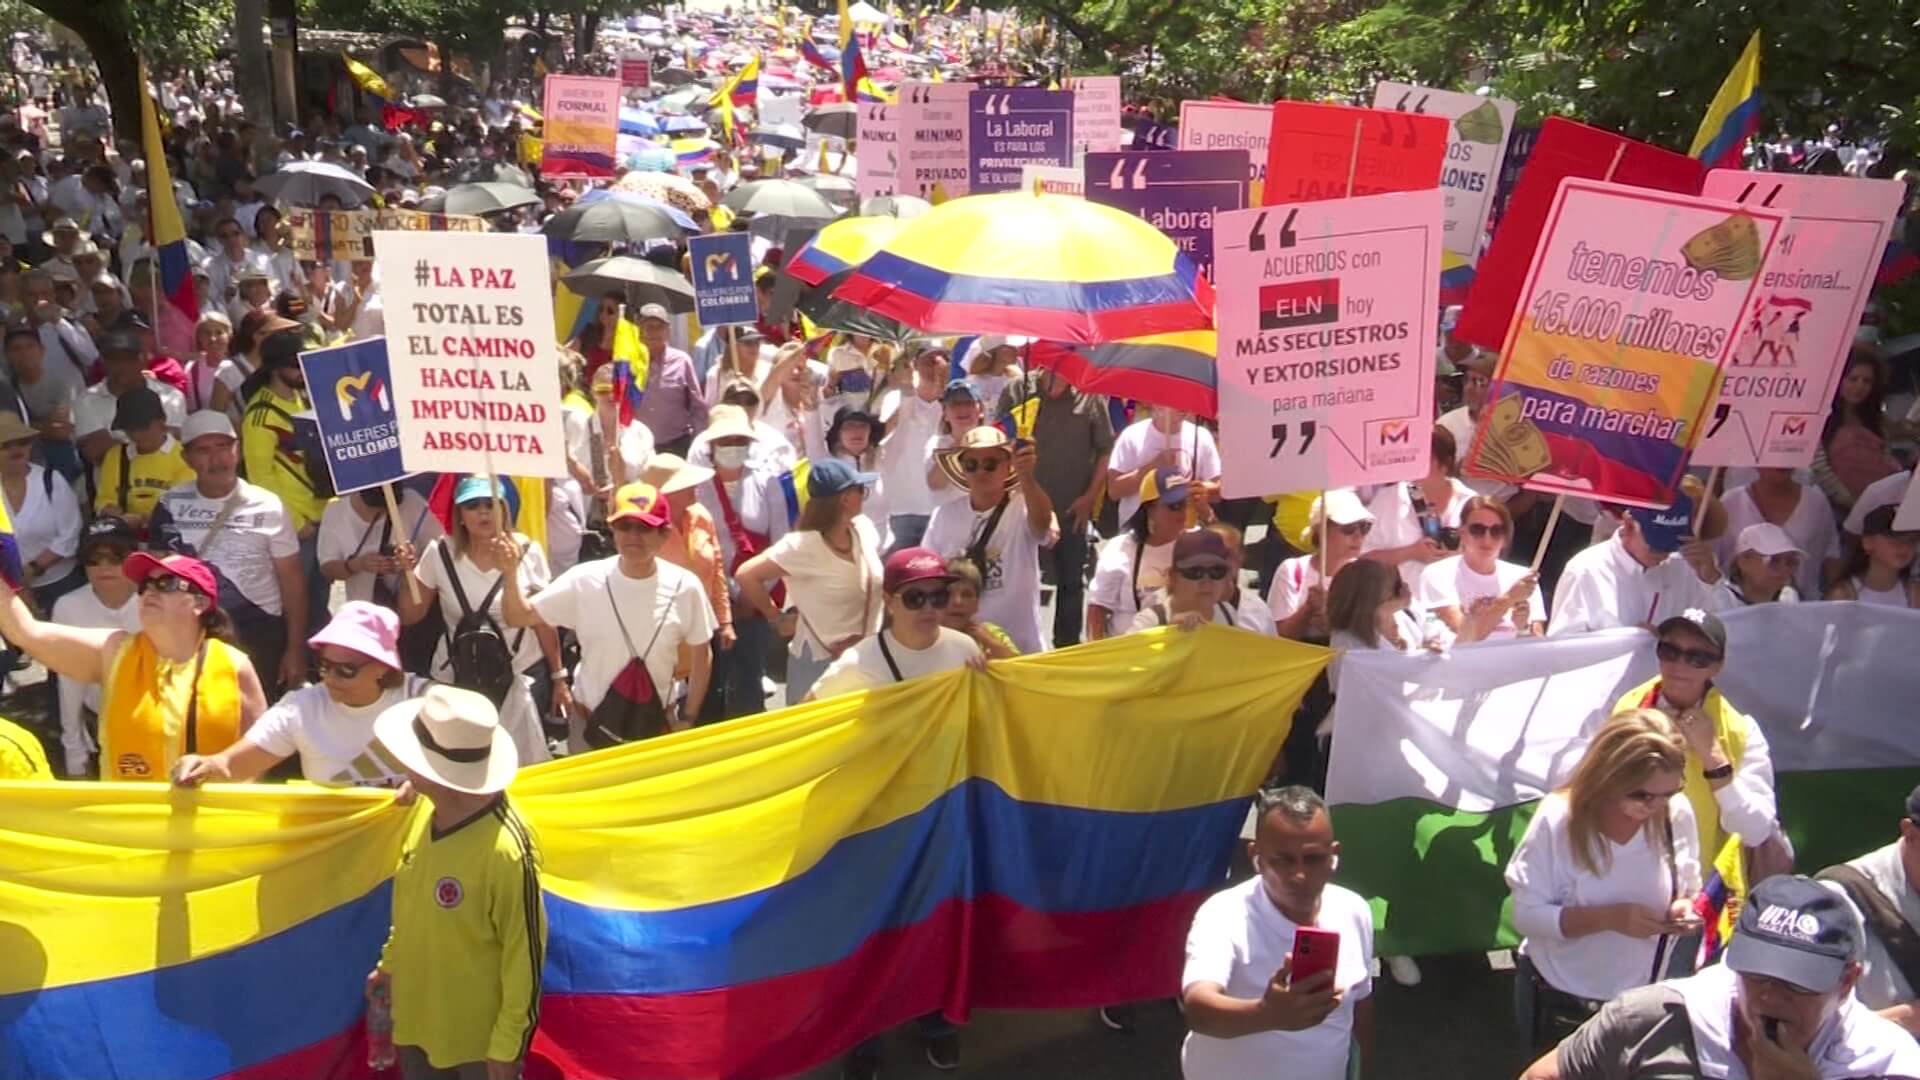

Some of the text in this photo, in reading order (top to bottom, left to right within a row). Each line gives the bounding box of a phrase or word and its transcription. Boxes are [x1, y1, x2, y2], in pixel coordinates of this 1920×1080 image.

[557, 101, 607, 112] FORMAL
[862, 130, 896, 142] NUNCA
[986, 120, 1053, 137] La Laboral
[1190, 129, 1271, 151] la pension
[916, 168, 967, 179] PRIVADO
[1263, 250, 1381, 279] ACUERDOS con
[1567, 241, 1718, 301] tenemos
[469, 267, 516, 289] PAZ
[412, 302, 524, 326] TOTAL ES
[1276, 295, 1374, 319] ELN hoy
[1533, 289, 1725, 359] 15.000 millones
[408, 336, 535, 359] EL CAMINO
[1236, 322, 1408, 356] MÁS SECUESTROS
[420, 367, 532, 391] HACIA LA
[1247, 353, 1401, 386] Y EXTORSIONES
[1546, 355, 1660, 393] de razones
[411, 399, 546, 424] IMPUNIDAD
[1273, 386, 1374, 416] para mañana
[1519, 396, 1686, 441] para marchar
[326, 423, 389, 448] MUJERES
[422, 431, 544, 455] ABSOLUTA
[336, 435, 399, 461] COLOMB
